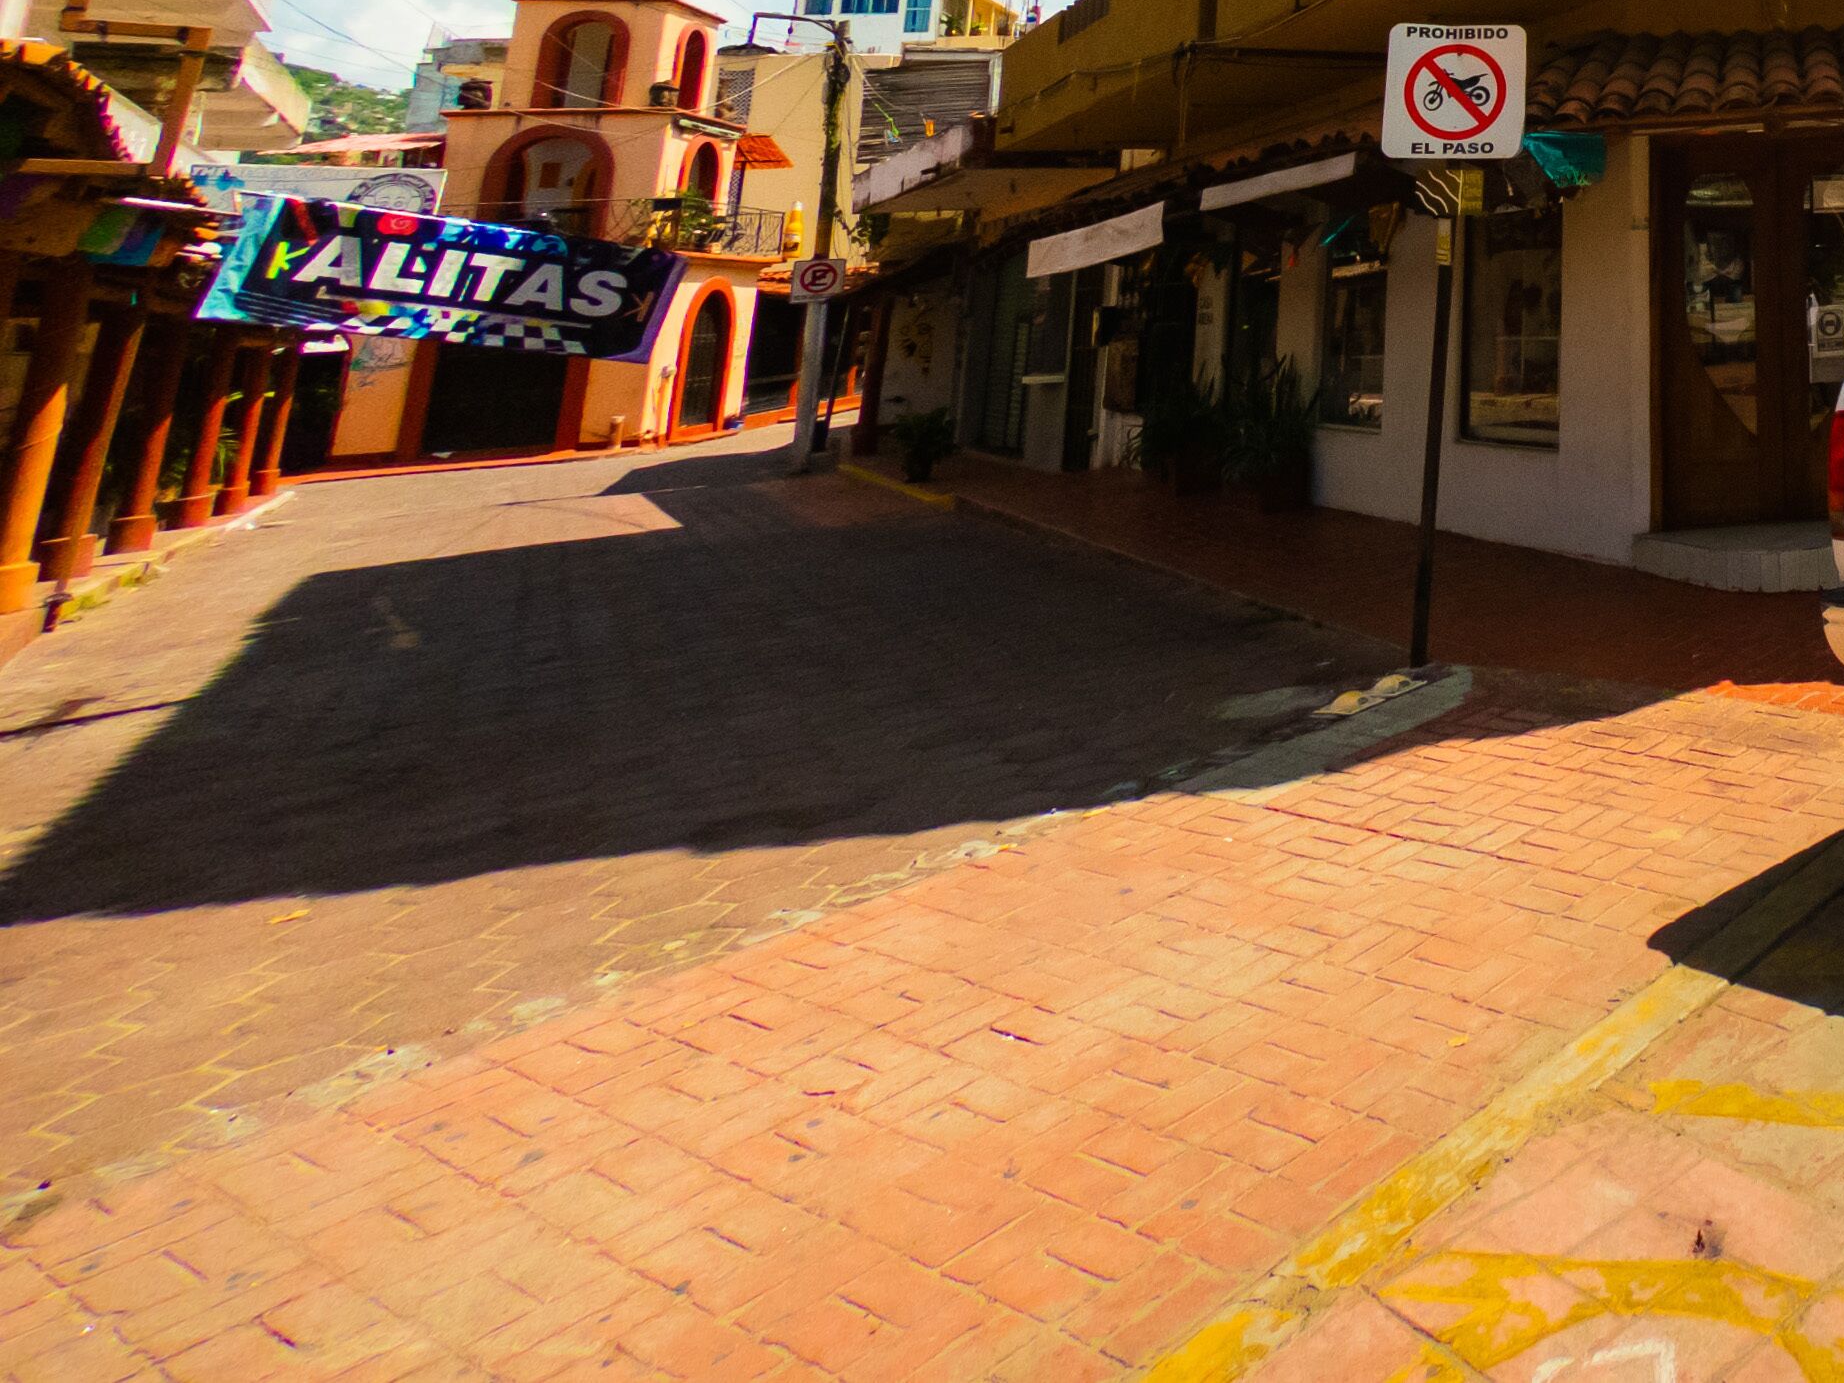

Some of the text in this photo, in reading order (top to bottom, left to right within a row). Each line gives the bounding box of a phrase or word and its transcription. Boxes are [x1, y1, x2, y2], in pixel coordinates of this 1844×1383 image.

[1406, 26, 1509, 39] PROHIBIDO
[1411, 143, 1494, 154] EL PASO
